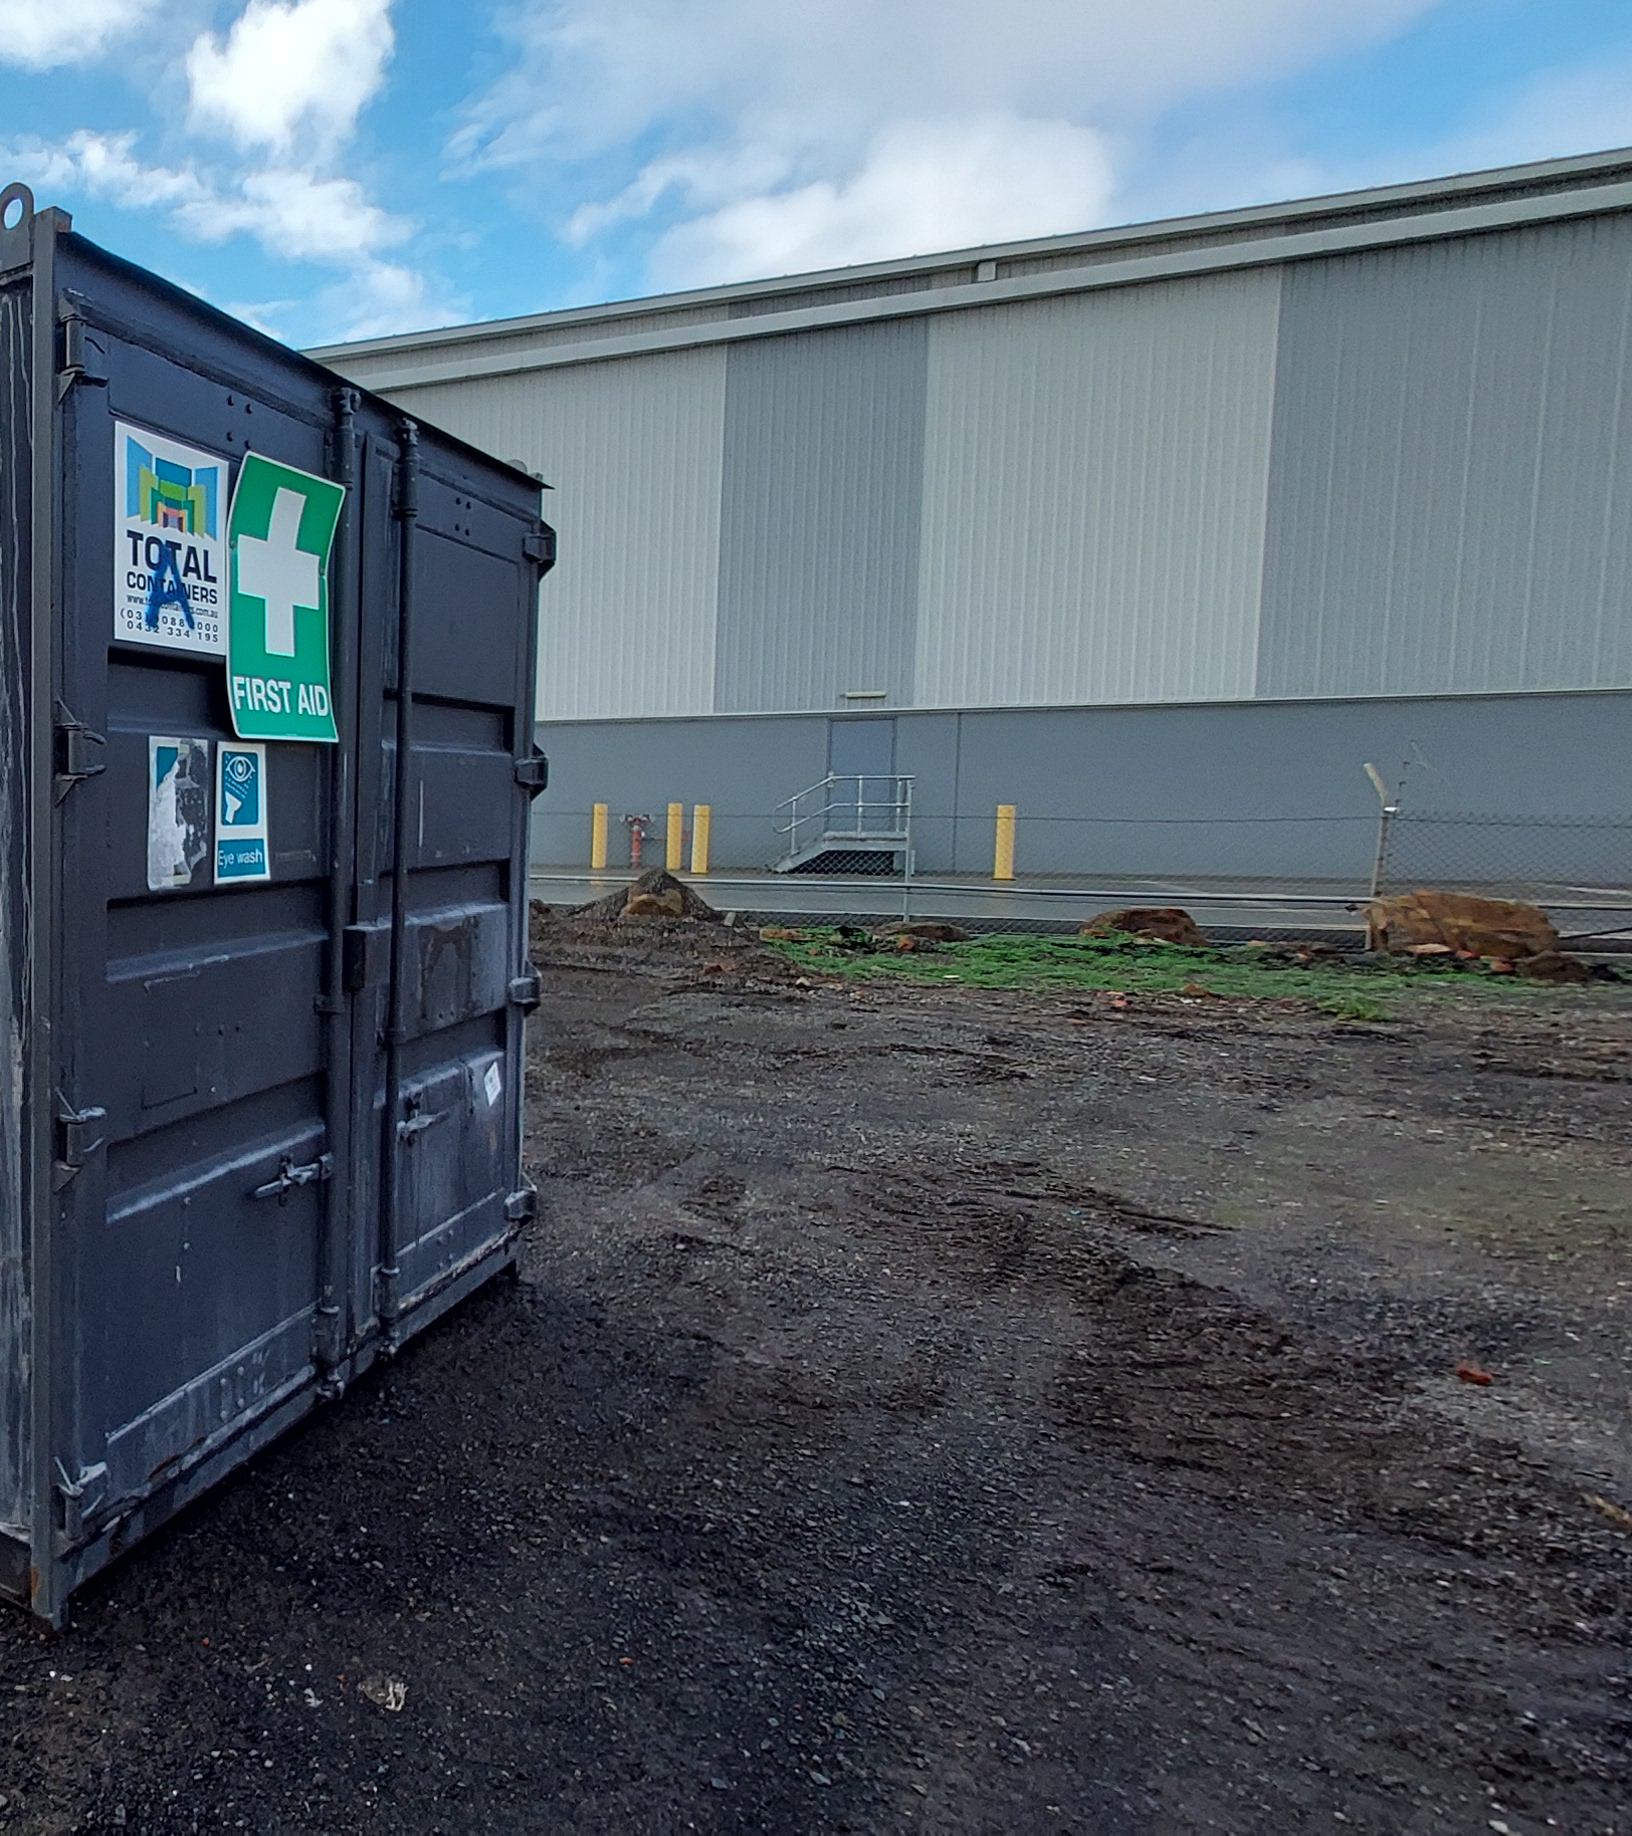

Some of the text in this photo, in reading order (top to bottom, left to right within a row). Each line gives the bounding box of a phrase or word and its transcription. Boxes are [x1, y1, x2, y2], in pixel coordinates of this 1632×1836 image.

[126, 529, 218, 584] TOTAL
[126, 571, 219, 605] CONTANERS
[120, 608, 219, 633] (03 088 000
[167, 627, 191, 638] 334
[197, 632, 219, 643] 195
[232, 676, 329, 717] FIRST AID
[219, 848, 263, 869] Eye wash
